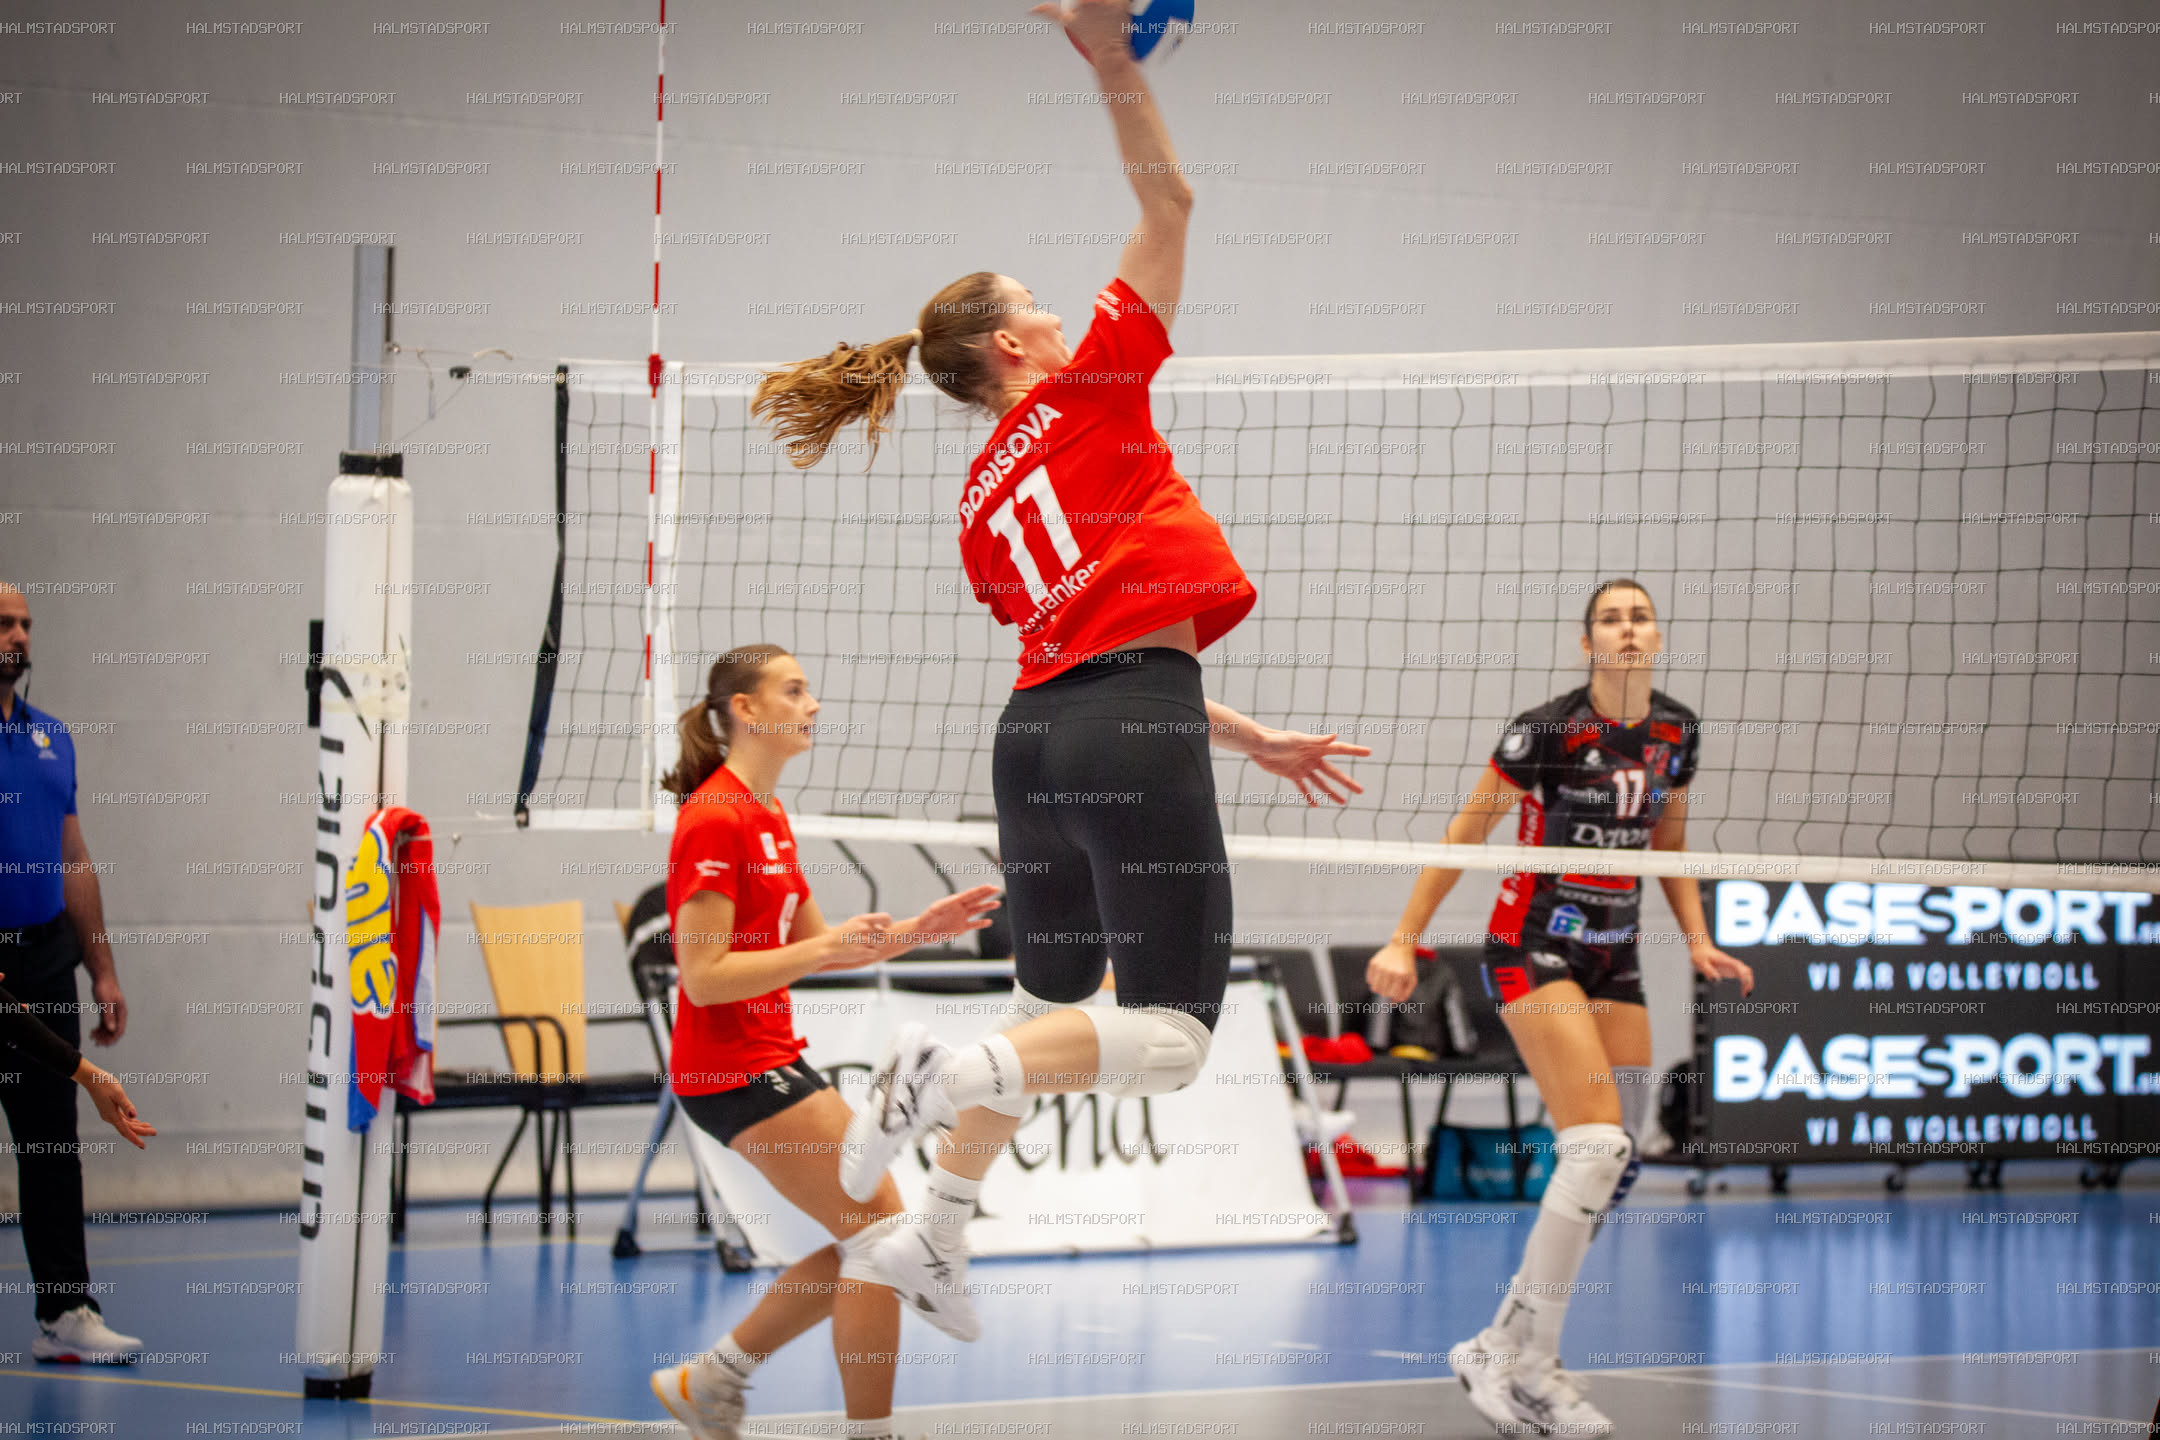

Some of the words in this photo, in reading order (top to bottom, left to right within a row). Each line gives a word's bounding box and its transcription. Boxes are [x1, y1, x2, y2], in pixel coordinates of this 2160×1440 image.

[960, 403, 1062, 528] BORISOVA
[987, 465, 1082, 604] 11
[1612, 768, 1645, 820] 17
[1808, 962, 1840, 991] VI
[1907, 962, 2099, 991] VOLLEYBOLL
[1806, 1117, 1839, 1145] VI
[1905, 1115, 2097, 1144] VOLLEYBOLL
